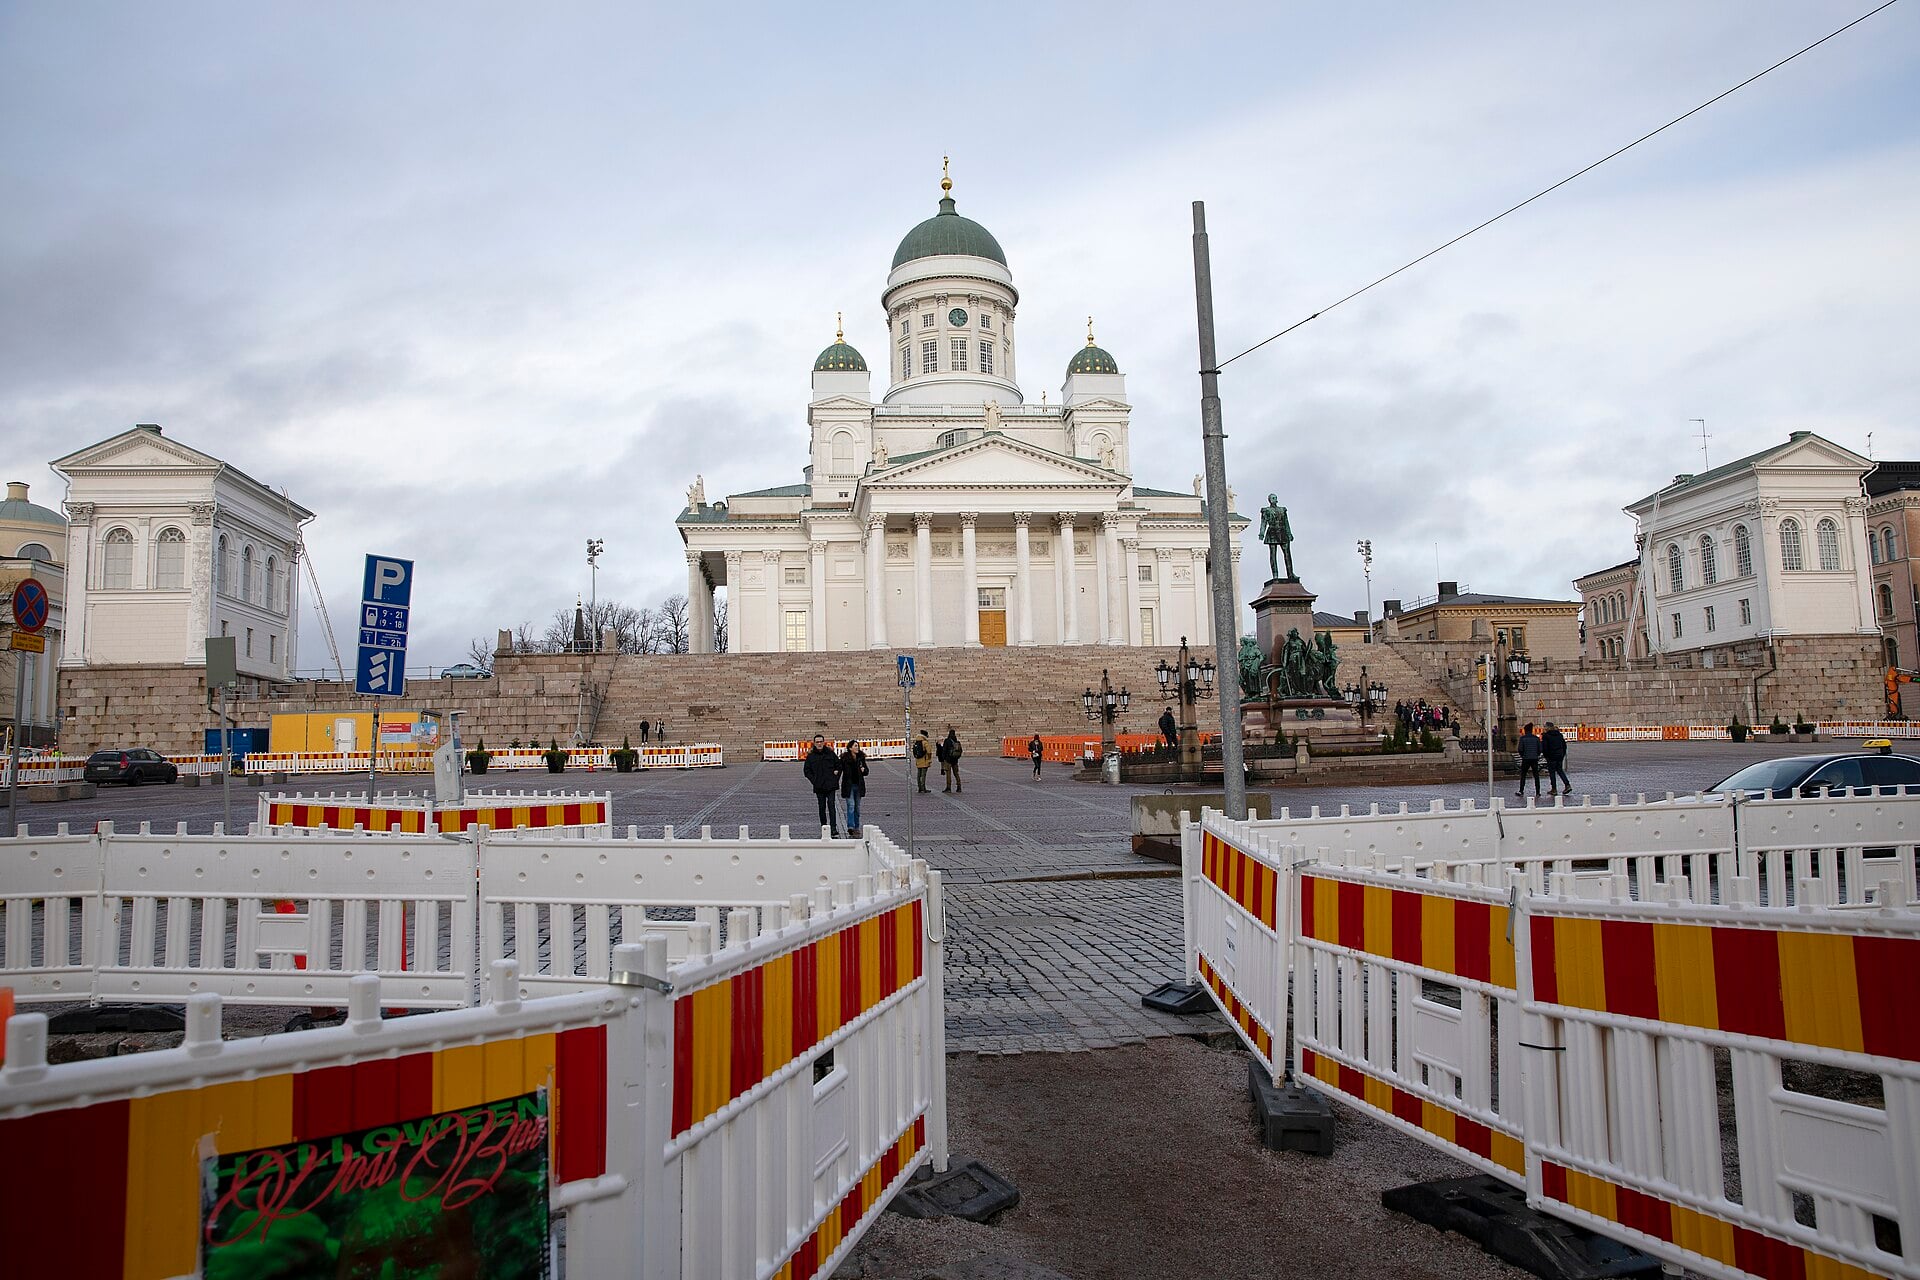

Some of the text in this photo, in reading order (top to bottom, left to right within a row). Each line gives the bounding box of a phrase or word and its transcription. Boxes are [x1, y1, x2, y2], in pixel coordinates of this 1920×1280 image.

[373, 559, 405, 600] P
[382, 610, 388, 618] 9
[395, 611, 403, 619] 21
[213, 1095, 547, 1180] HALLOWEEN
